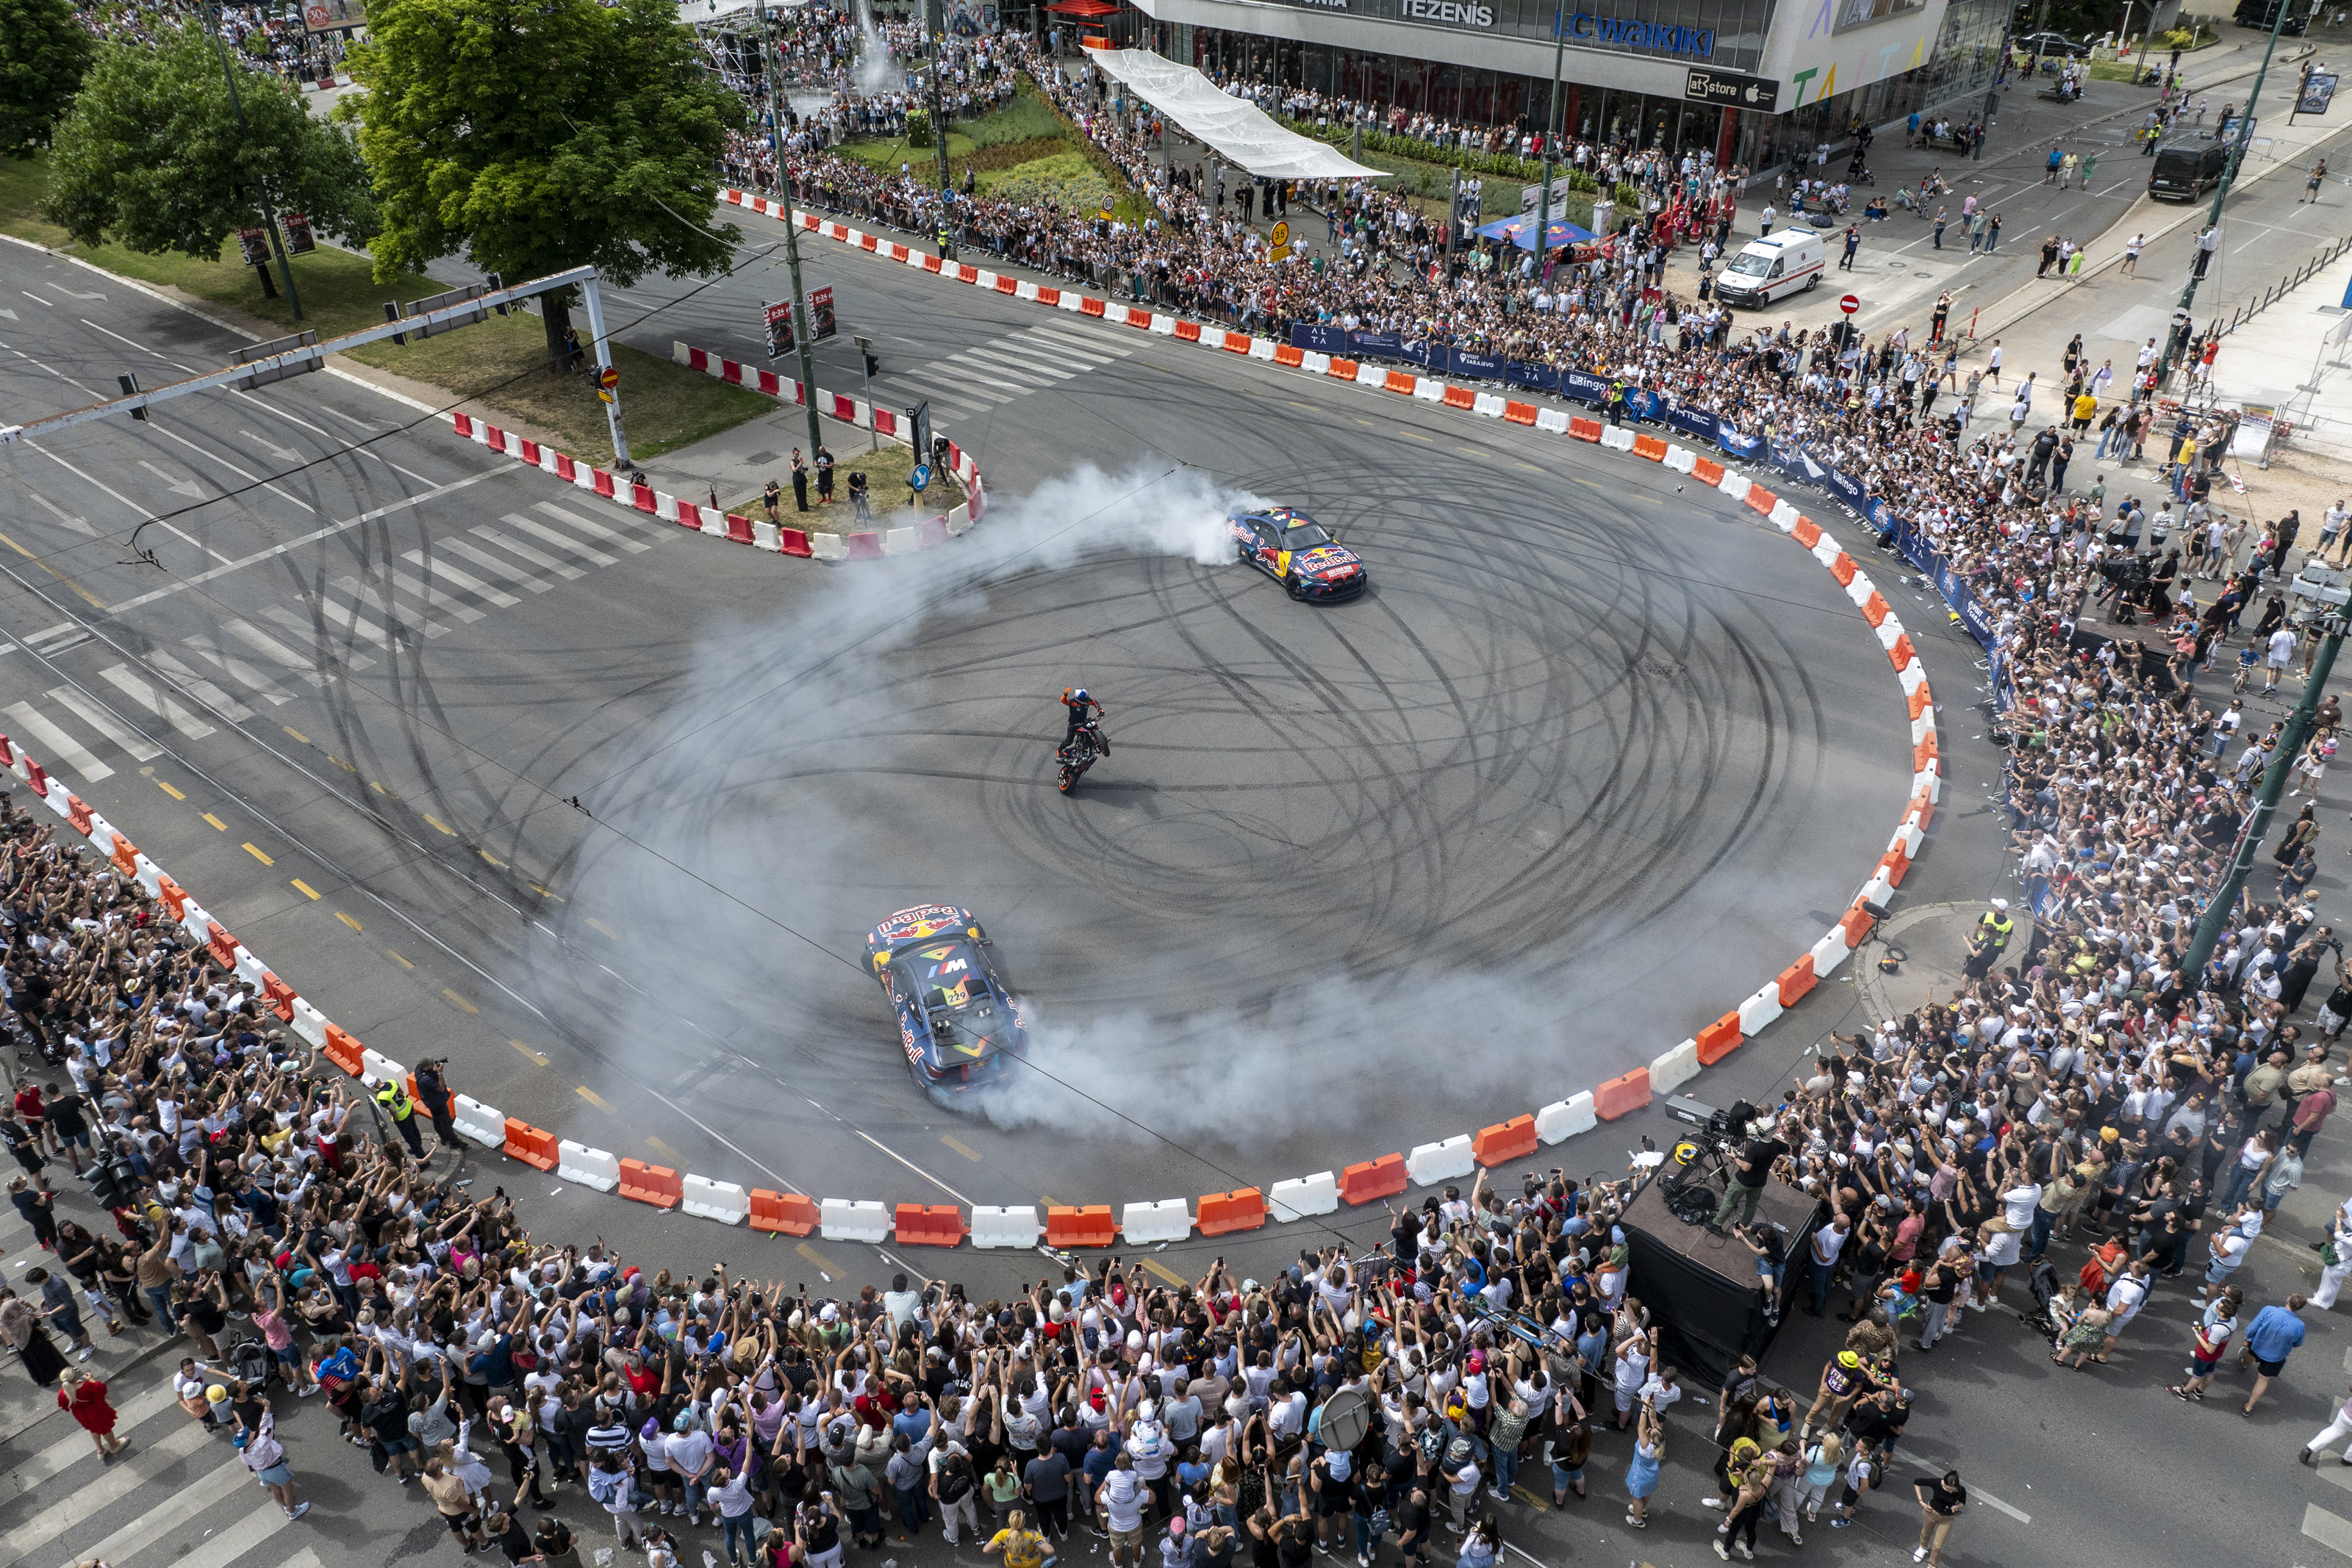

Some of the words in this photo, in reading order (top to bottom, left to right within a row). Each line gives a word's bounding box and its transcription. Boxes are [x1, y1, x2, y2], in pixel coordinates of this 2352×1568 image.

[1708, 82, 1737, 96] store
[1105, 198, 1113, 207] 60
[280, 217, 295, 253] CASINO
[808, 294, 818, 339] CASINO
[763, 309, 775, 356] CASINO
[1466, 359, 1494, 368] SARAJEVO
[1577, 376, 1607, 391] Bingo
[1838, 472, 1858, 496] Bingo
[1237, 525, 1255, 544] Bull
[1303, 558, 1335, 572] Red
[1330, 553, 1358, 565] Bull
[1972, 603, 1983, 617] VISIT
[1968, 611, 1989, 634] SARAJEVO
[914, 906, 959, 921] Red
[877, 913, 918, 935] Bull
[947, 992, 966, 1003] 229
[337, 1362, 349, 1375] 7
